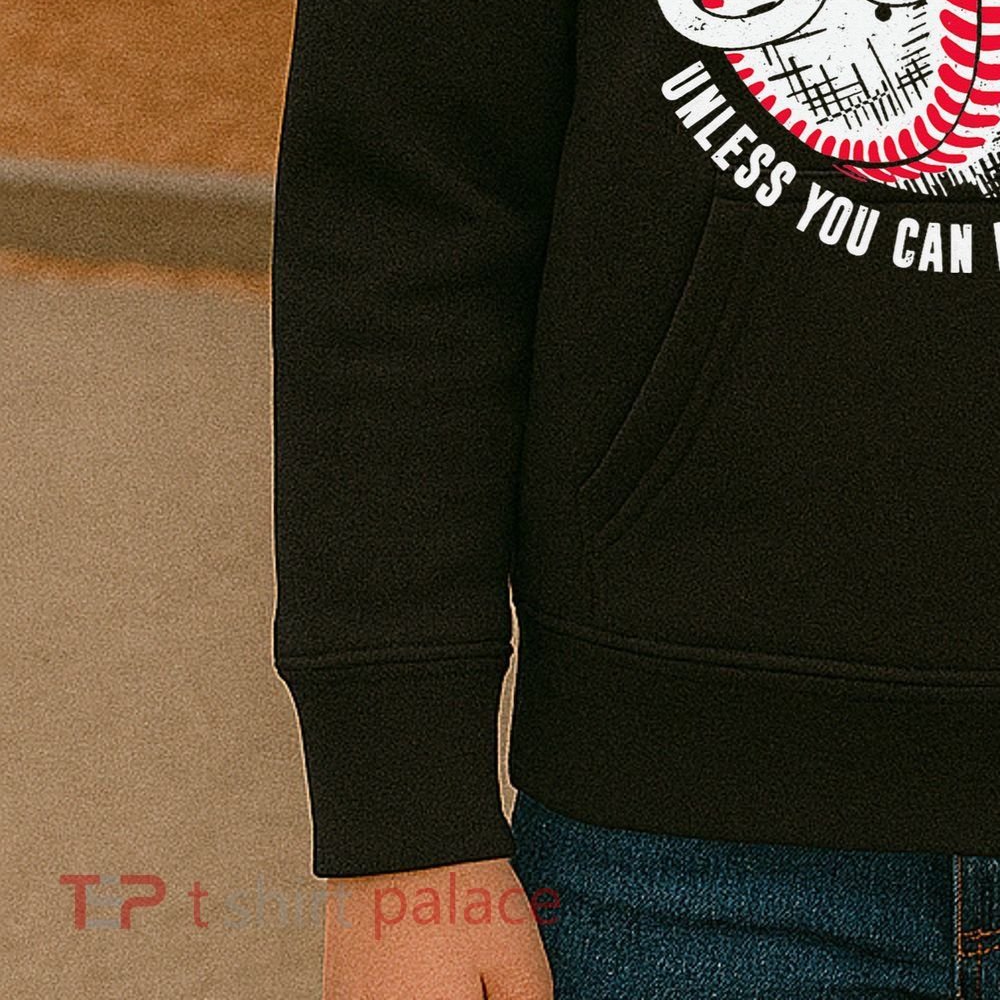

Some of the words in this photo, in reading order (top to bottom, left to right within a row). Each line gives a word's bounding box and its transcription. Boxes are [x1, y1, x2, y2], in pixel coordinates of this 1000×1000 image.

[661, 61, 797, 207] UNLESS
[796, 182, 881, 257] YOU
[892, 217, 974, 274] CAN
